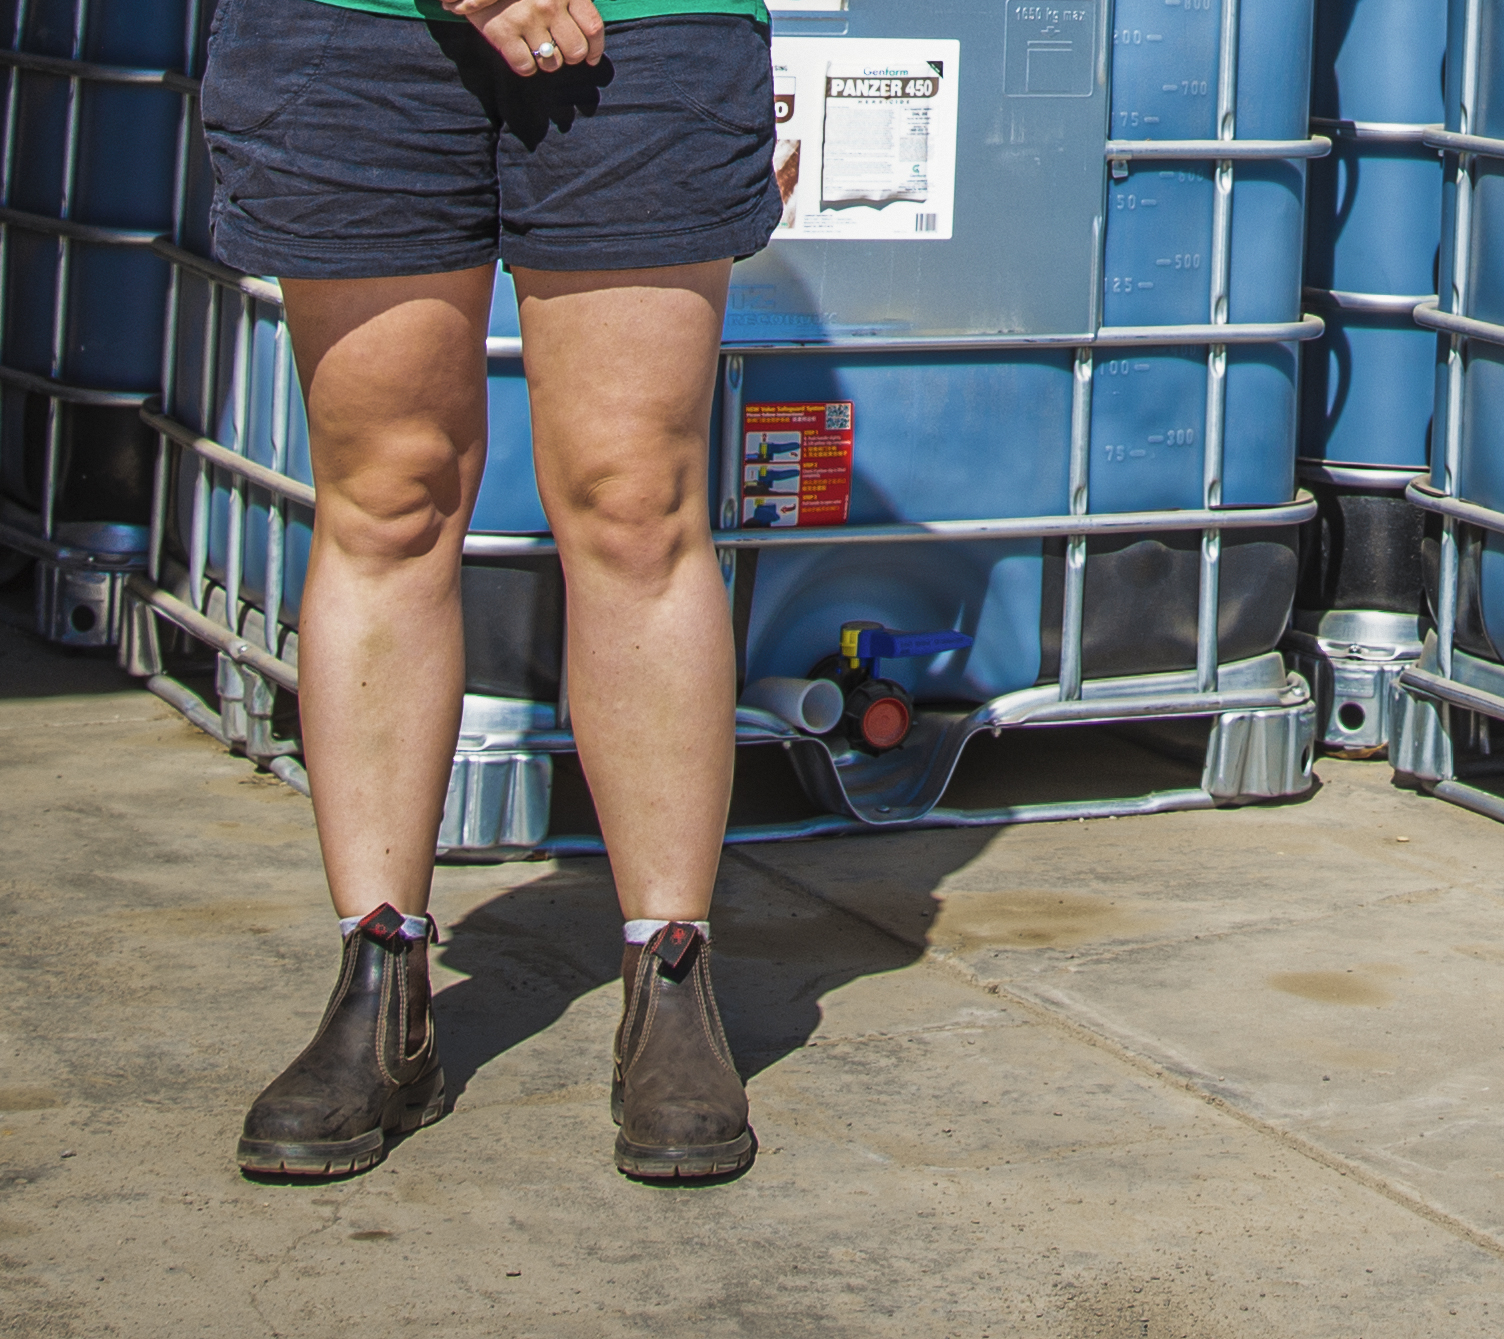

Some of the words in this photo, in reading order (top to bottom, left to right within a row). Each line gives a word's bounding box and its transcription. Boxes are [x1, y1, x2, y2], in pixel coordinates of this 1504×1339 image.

[863, 66, 909, 76] Genfarm
[830, 79, 902, 96] PANZER
[905, 79, 933, 96] 450
[1181, 80, 1208, 95] 700
